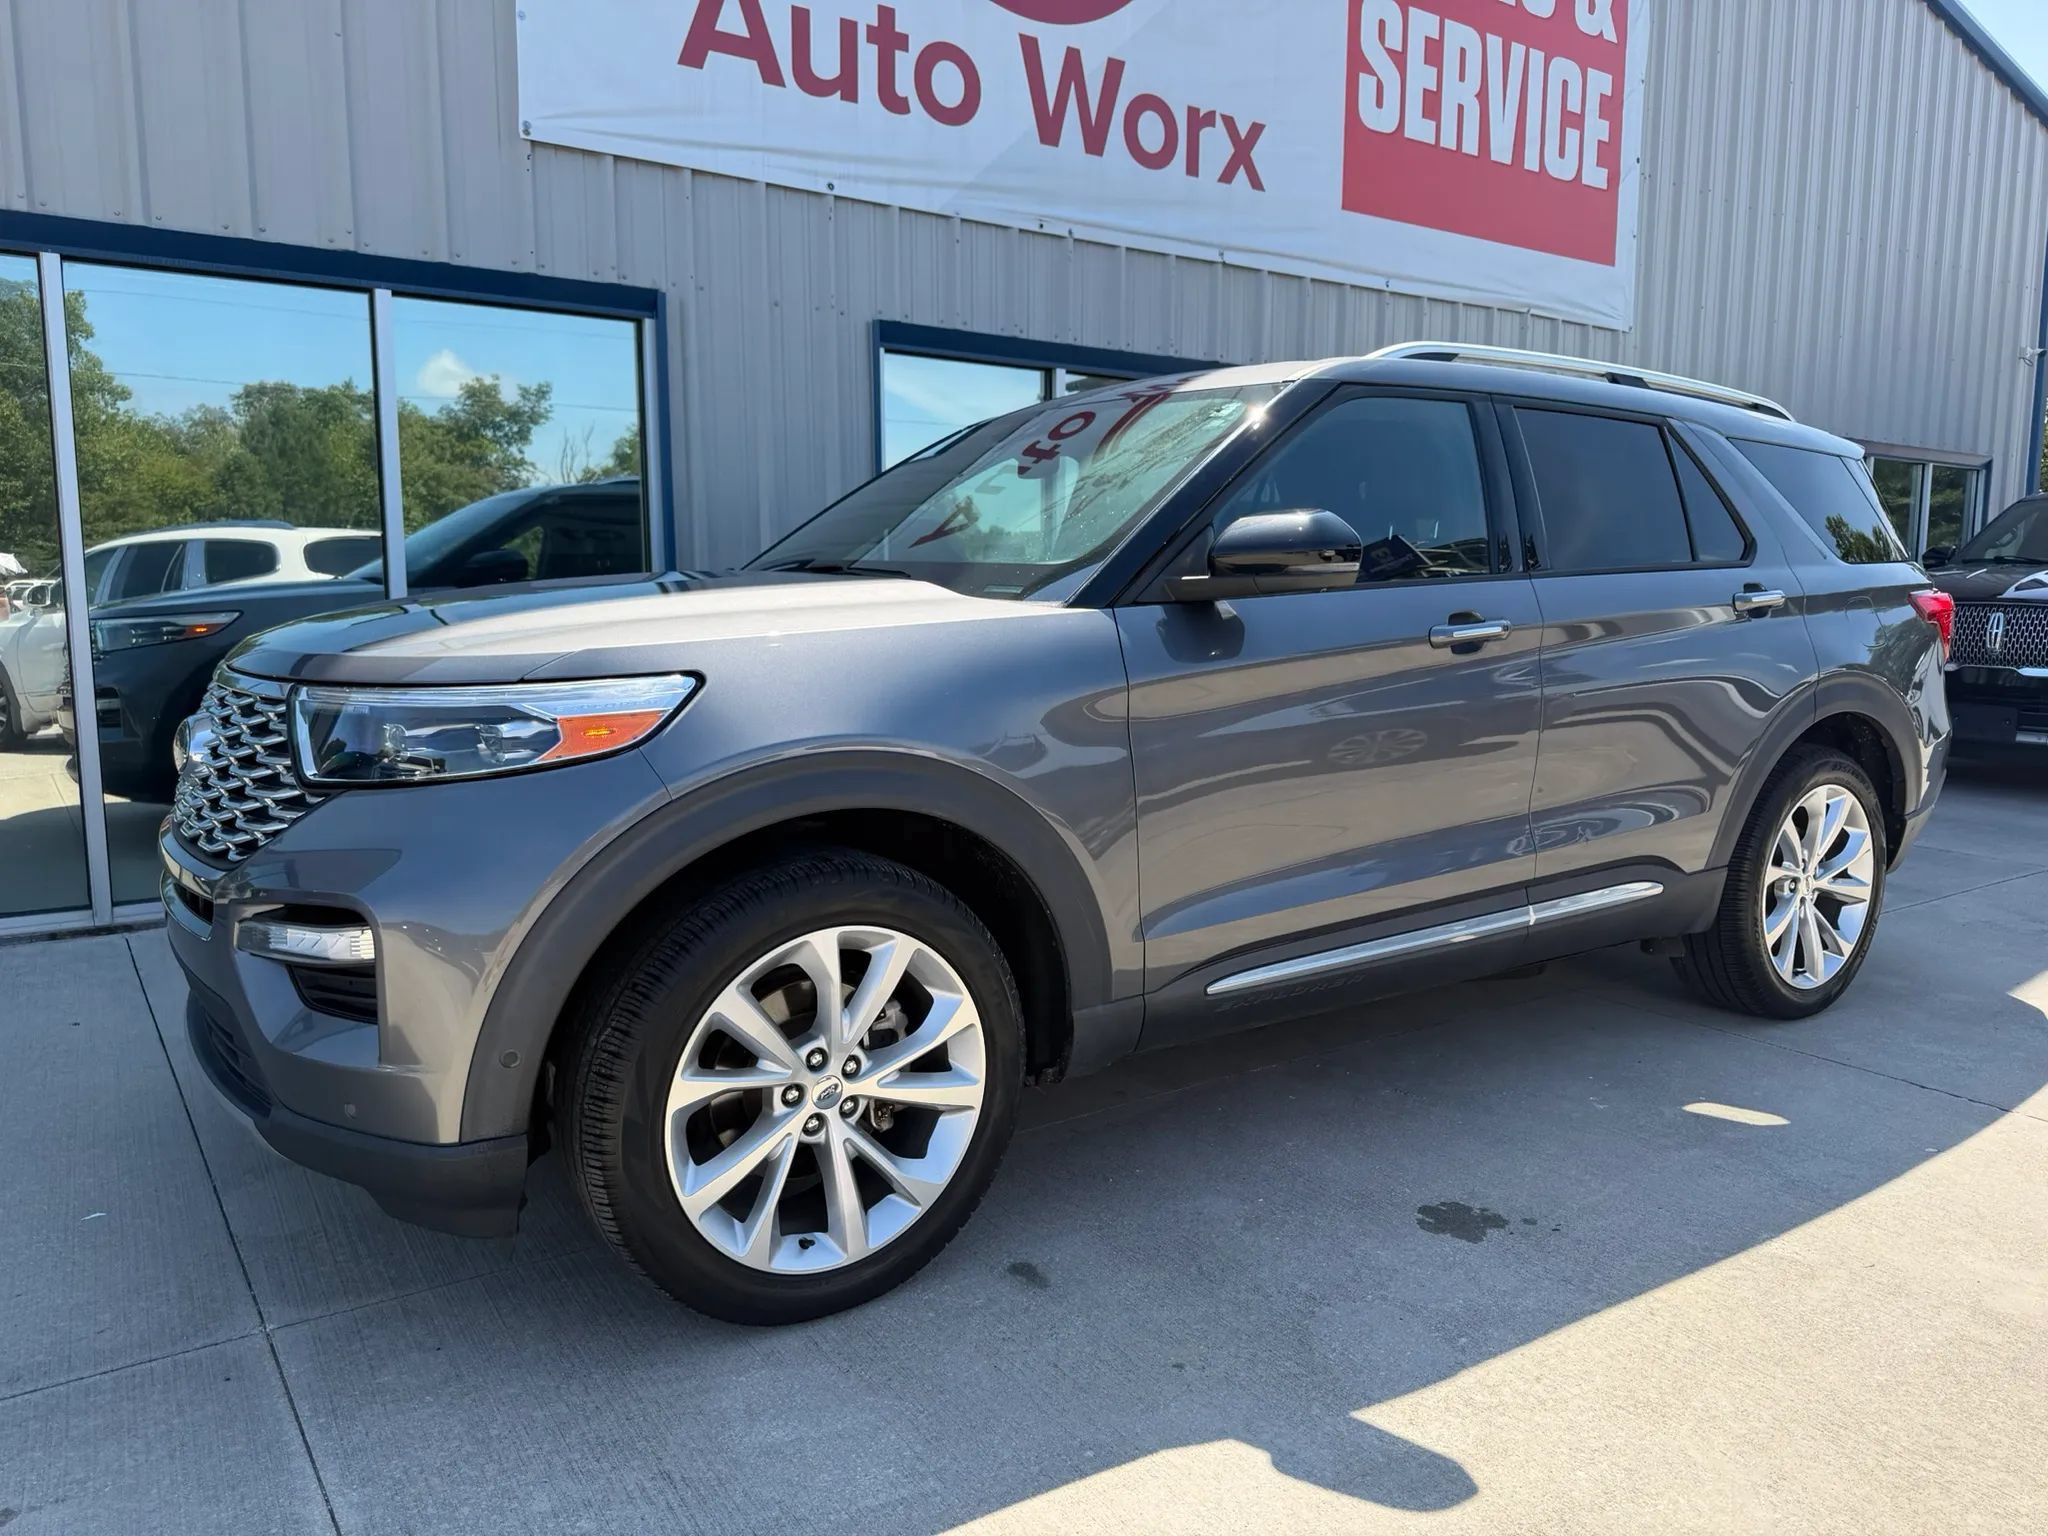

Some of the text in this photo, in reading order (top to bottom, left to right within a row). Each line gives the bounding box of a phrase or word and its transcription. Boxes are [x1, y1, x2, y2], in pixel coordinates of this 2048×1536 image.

[677, 0, 1266, 192] Auto Worx
[1358, 0, 1613, 190] SERVICE
